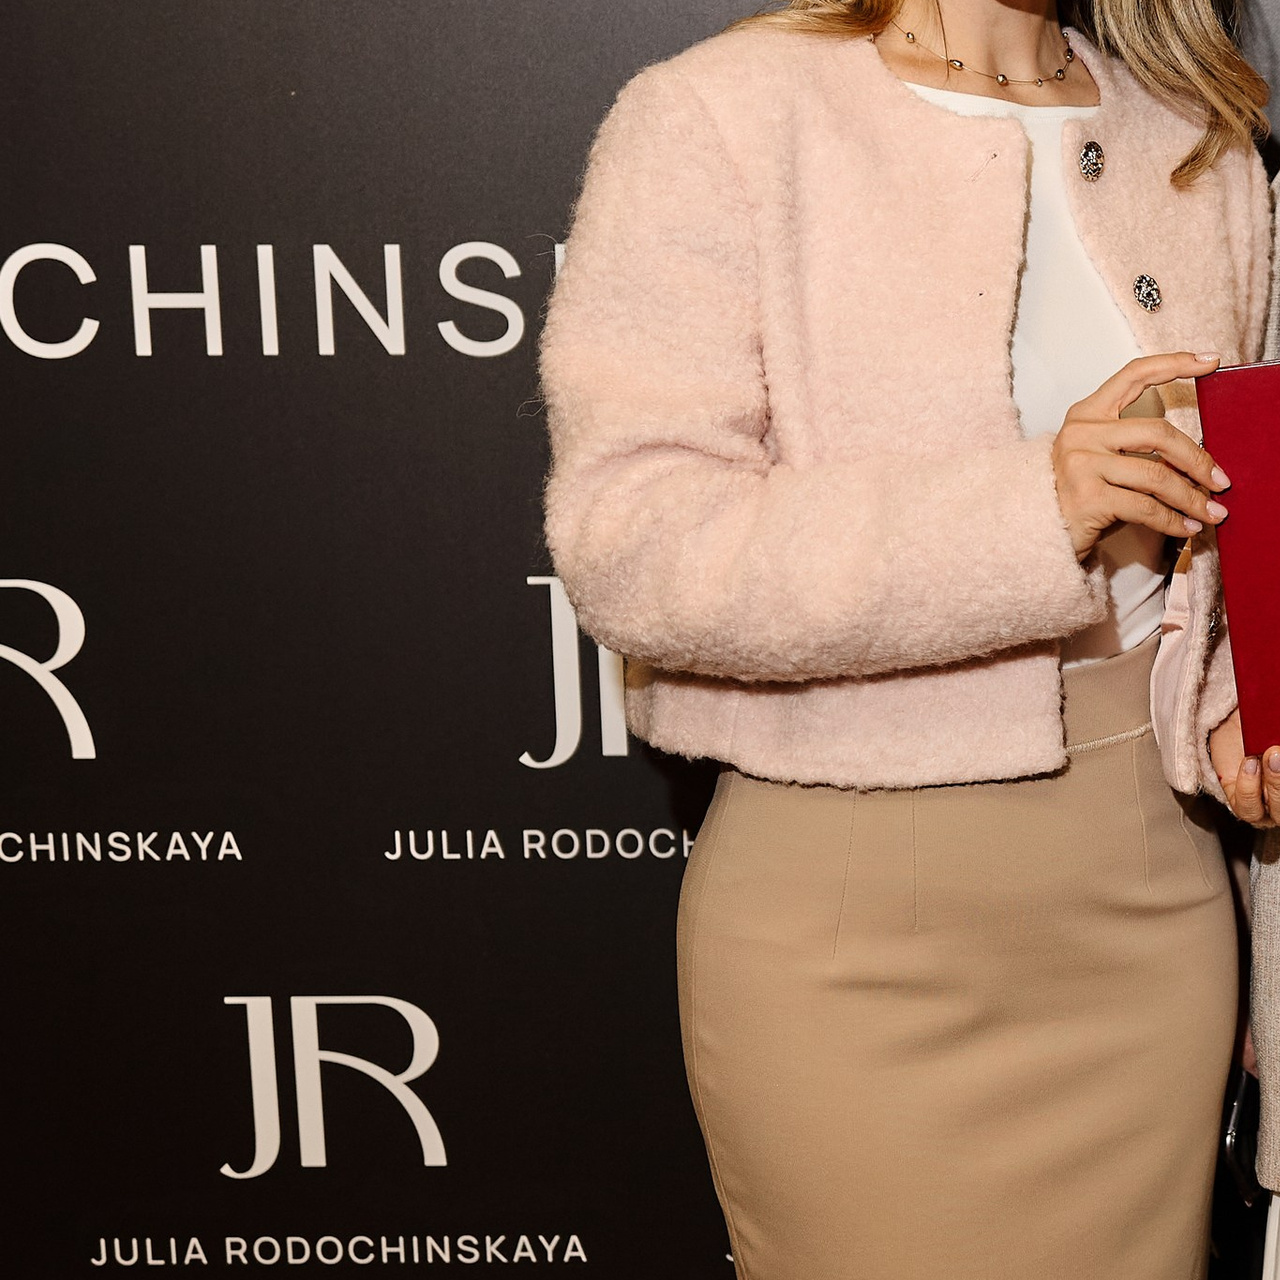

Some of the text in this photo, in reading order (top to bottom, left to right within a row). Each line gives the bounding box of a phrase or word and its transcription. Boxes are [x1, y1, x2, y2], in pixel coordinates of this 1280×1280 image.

[0, 241, 566, 359] CHINS
[385, 830, 504, 860] JULIA
[220, 996, 448, 1179] JR
[91, 1235, 588, 1266] JULIA RODOCHINSKAYA
